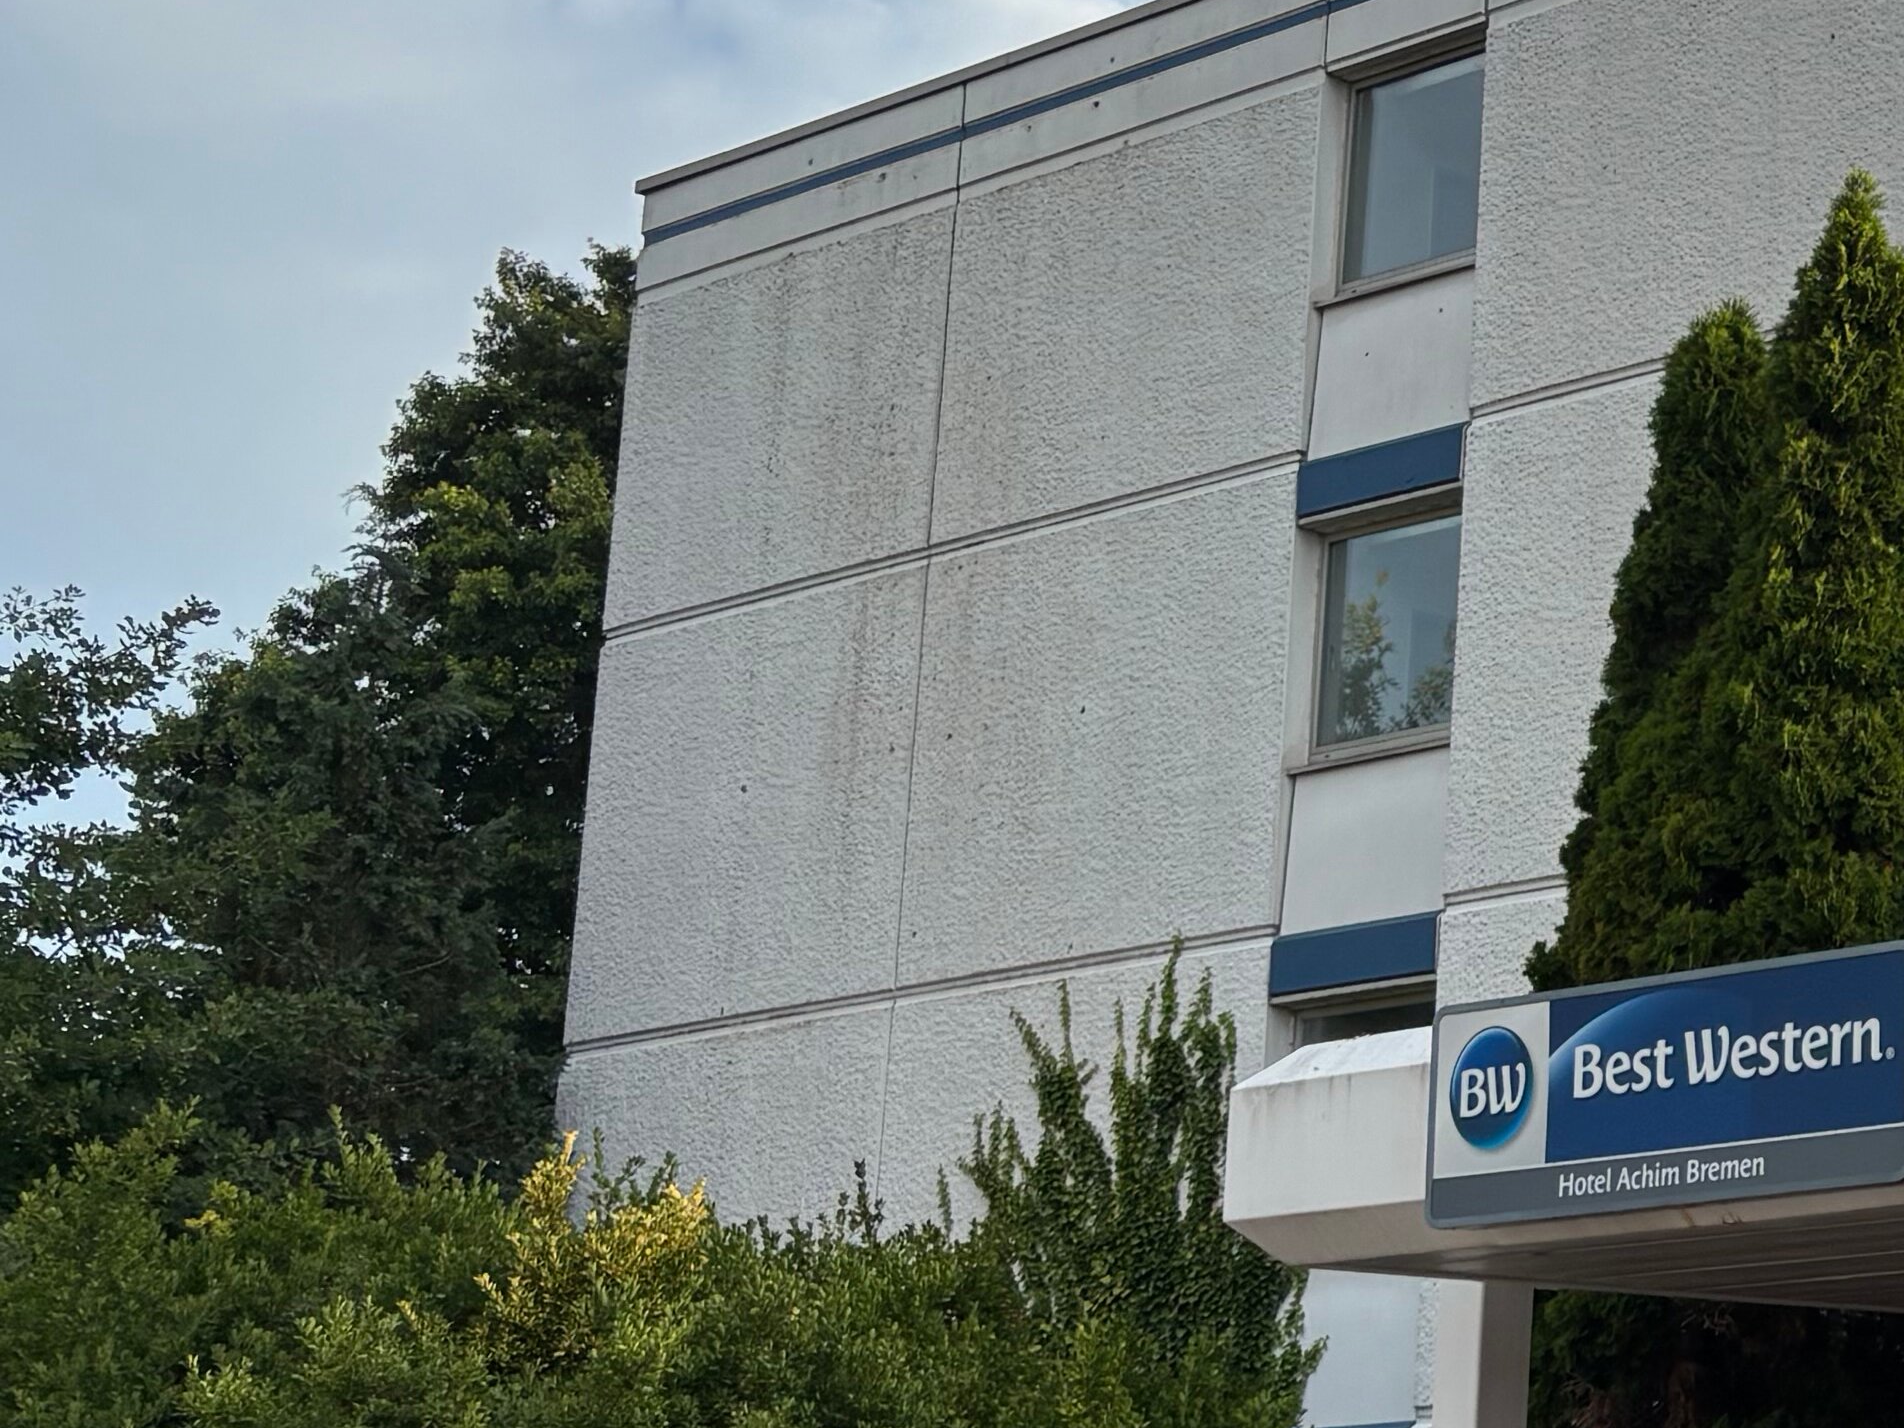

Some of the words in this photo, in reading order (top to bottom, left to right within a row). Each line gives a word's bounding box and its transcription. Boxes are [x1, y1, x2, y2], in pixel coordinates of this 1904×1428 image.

[1459, 1061, 1526, 1119] BW
[1573, 1039, 1675, 1099] Best
[1558, 1170, 1612, 1198] Hotel
[1616, 1162, 1680, 1192] Achim
[1686, 1156, 1765, 1184] Bremen
